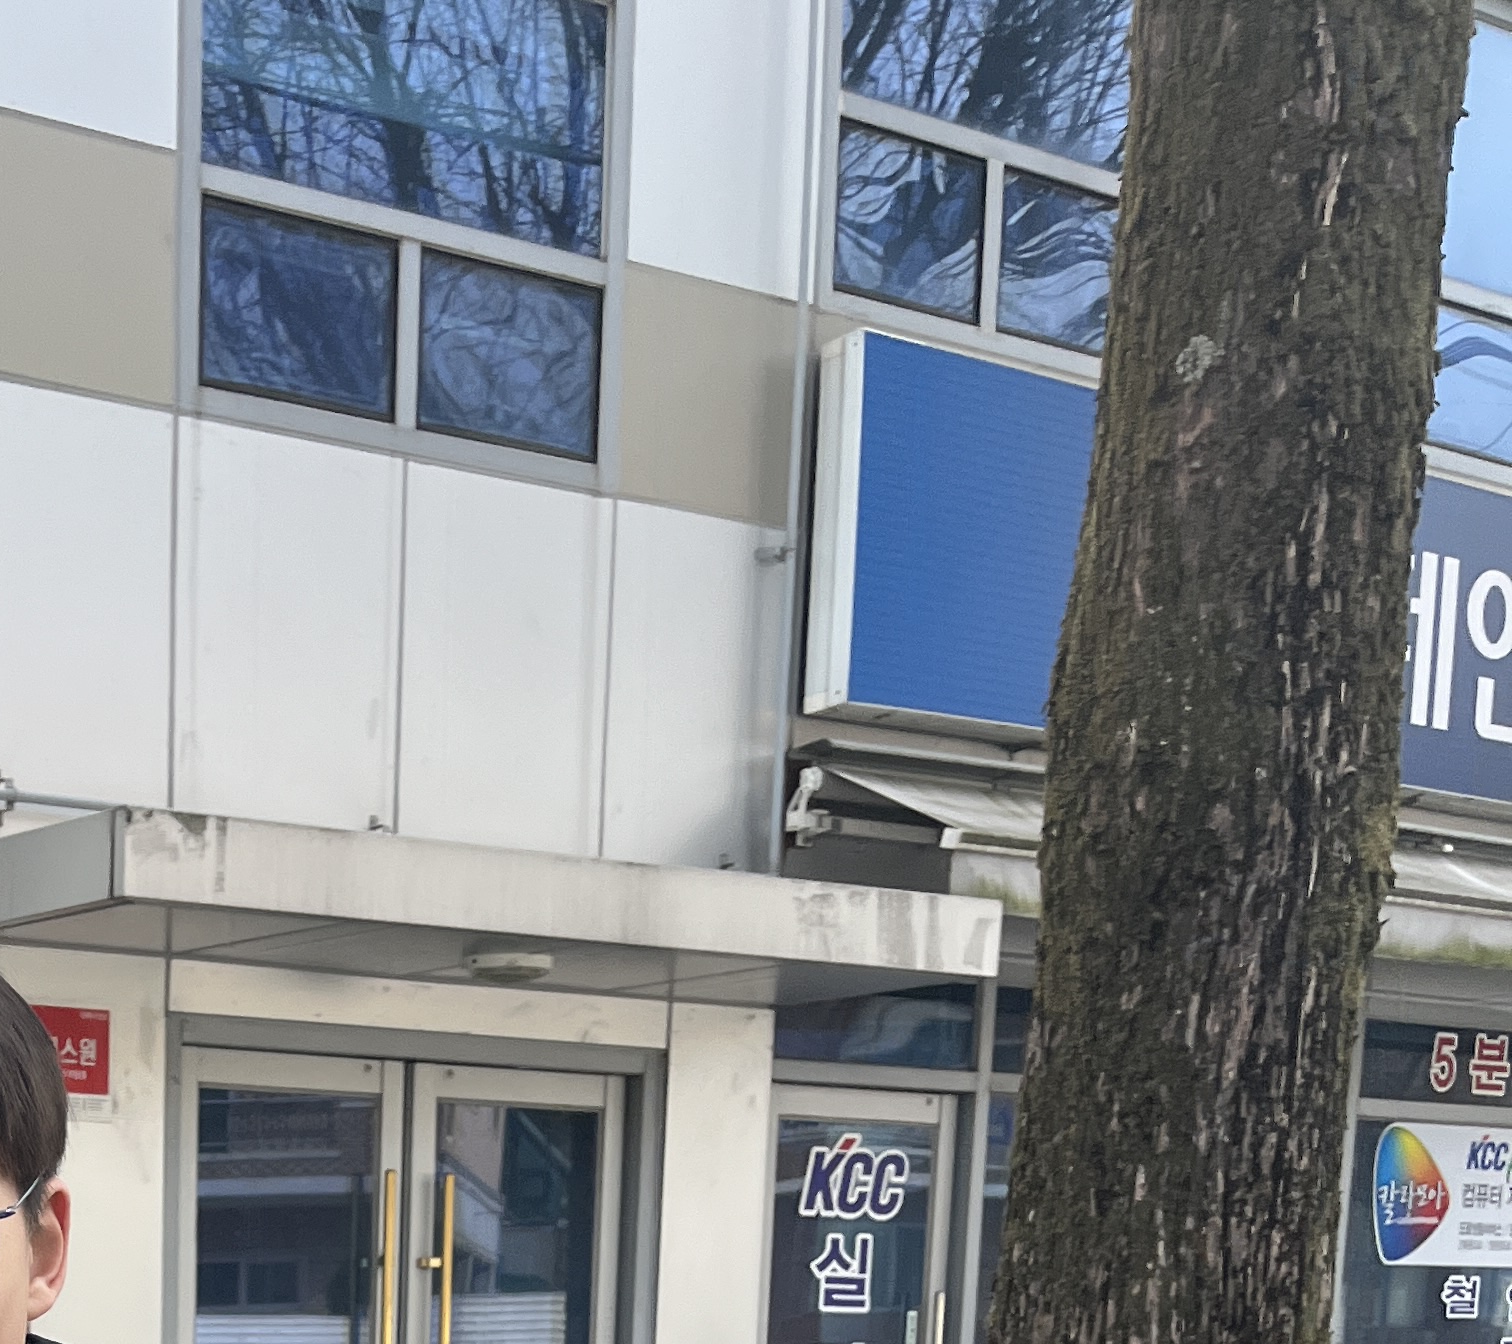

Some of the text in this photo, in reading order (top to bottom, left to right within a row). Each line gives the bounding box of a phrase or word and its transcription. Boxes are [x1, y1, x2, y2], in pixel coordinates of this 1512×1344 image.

[51, 1036, 97, 1067] 스원
[1466, 1134, 1509, 1171] KCC
[798, 1133, 909, 1221] KCC
[1441, 1275, 1481, 1319] 철
